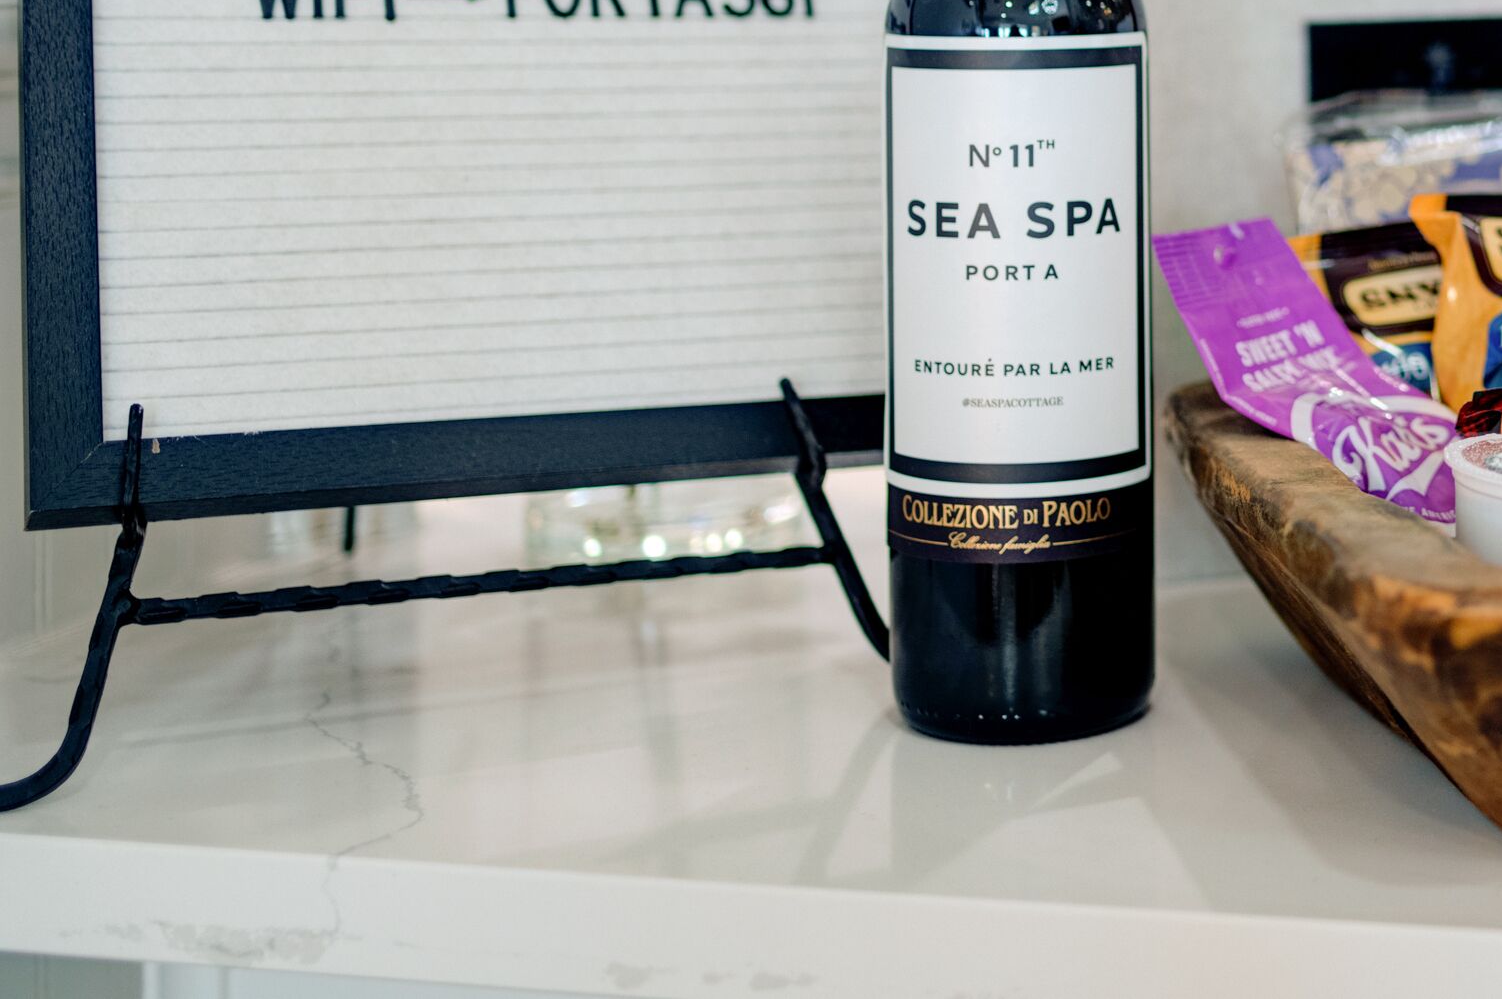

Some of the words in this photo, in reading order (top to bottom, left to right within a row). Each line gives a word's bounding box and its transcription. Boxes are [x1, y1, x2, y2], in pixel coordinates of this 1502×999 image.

[907, 199, 1001, 239] SEA
[1026, 198, 1120, 238] SPA
[914, 358, 995, 377] ENTOURÉ
[1003, 363, 1041, 376] PAR
[1050, 362, 1071, 375] LA
[1079, 357, 1115, 372] MER
[902, 494, 1019, 529] COLLEZIONE
[1042, 497, 1111, 528] PAOLO
